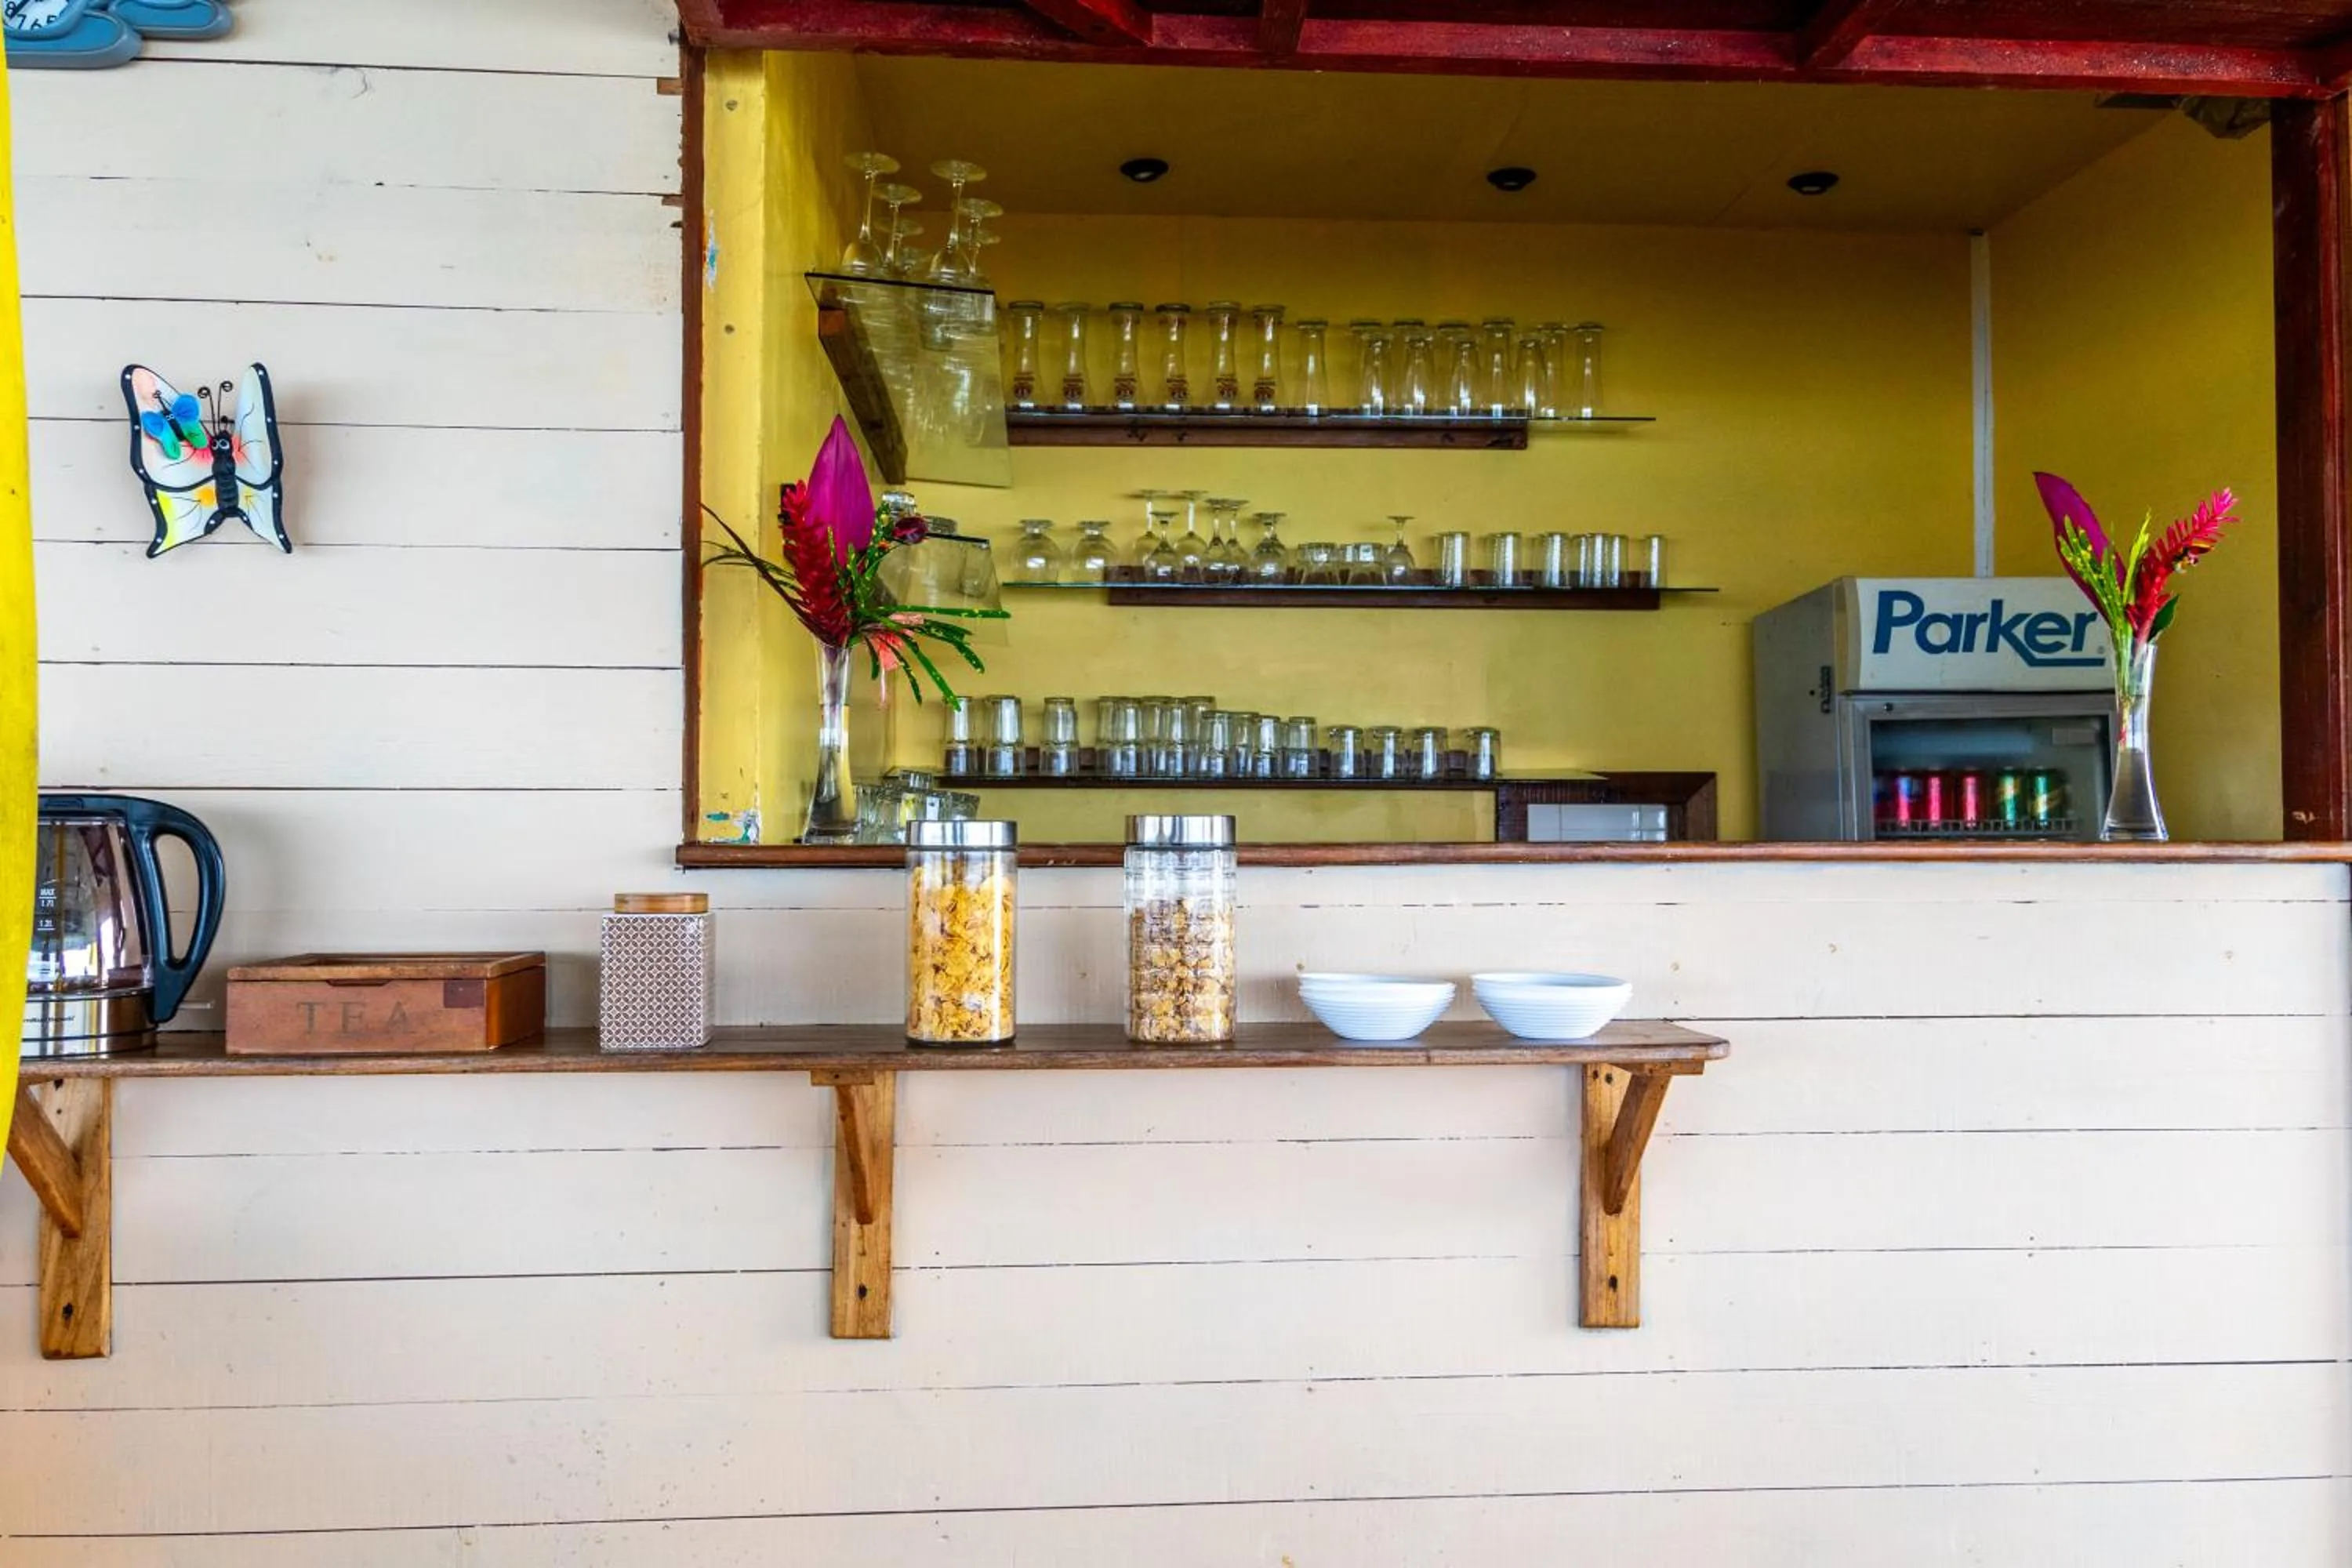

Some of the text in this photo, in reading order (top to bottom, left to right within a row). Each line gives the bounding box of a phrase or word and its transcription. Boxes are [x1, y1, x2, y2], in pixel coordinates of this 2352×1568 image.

[5, 2, 16, 19] 8
[17, 14, 27, 30] 7
[1872, 590, 2105, 667] Parker
[296, 1000, 417, 1036] TEA
